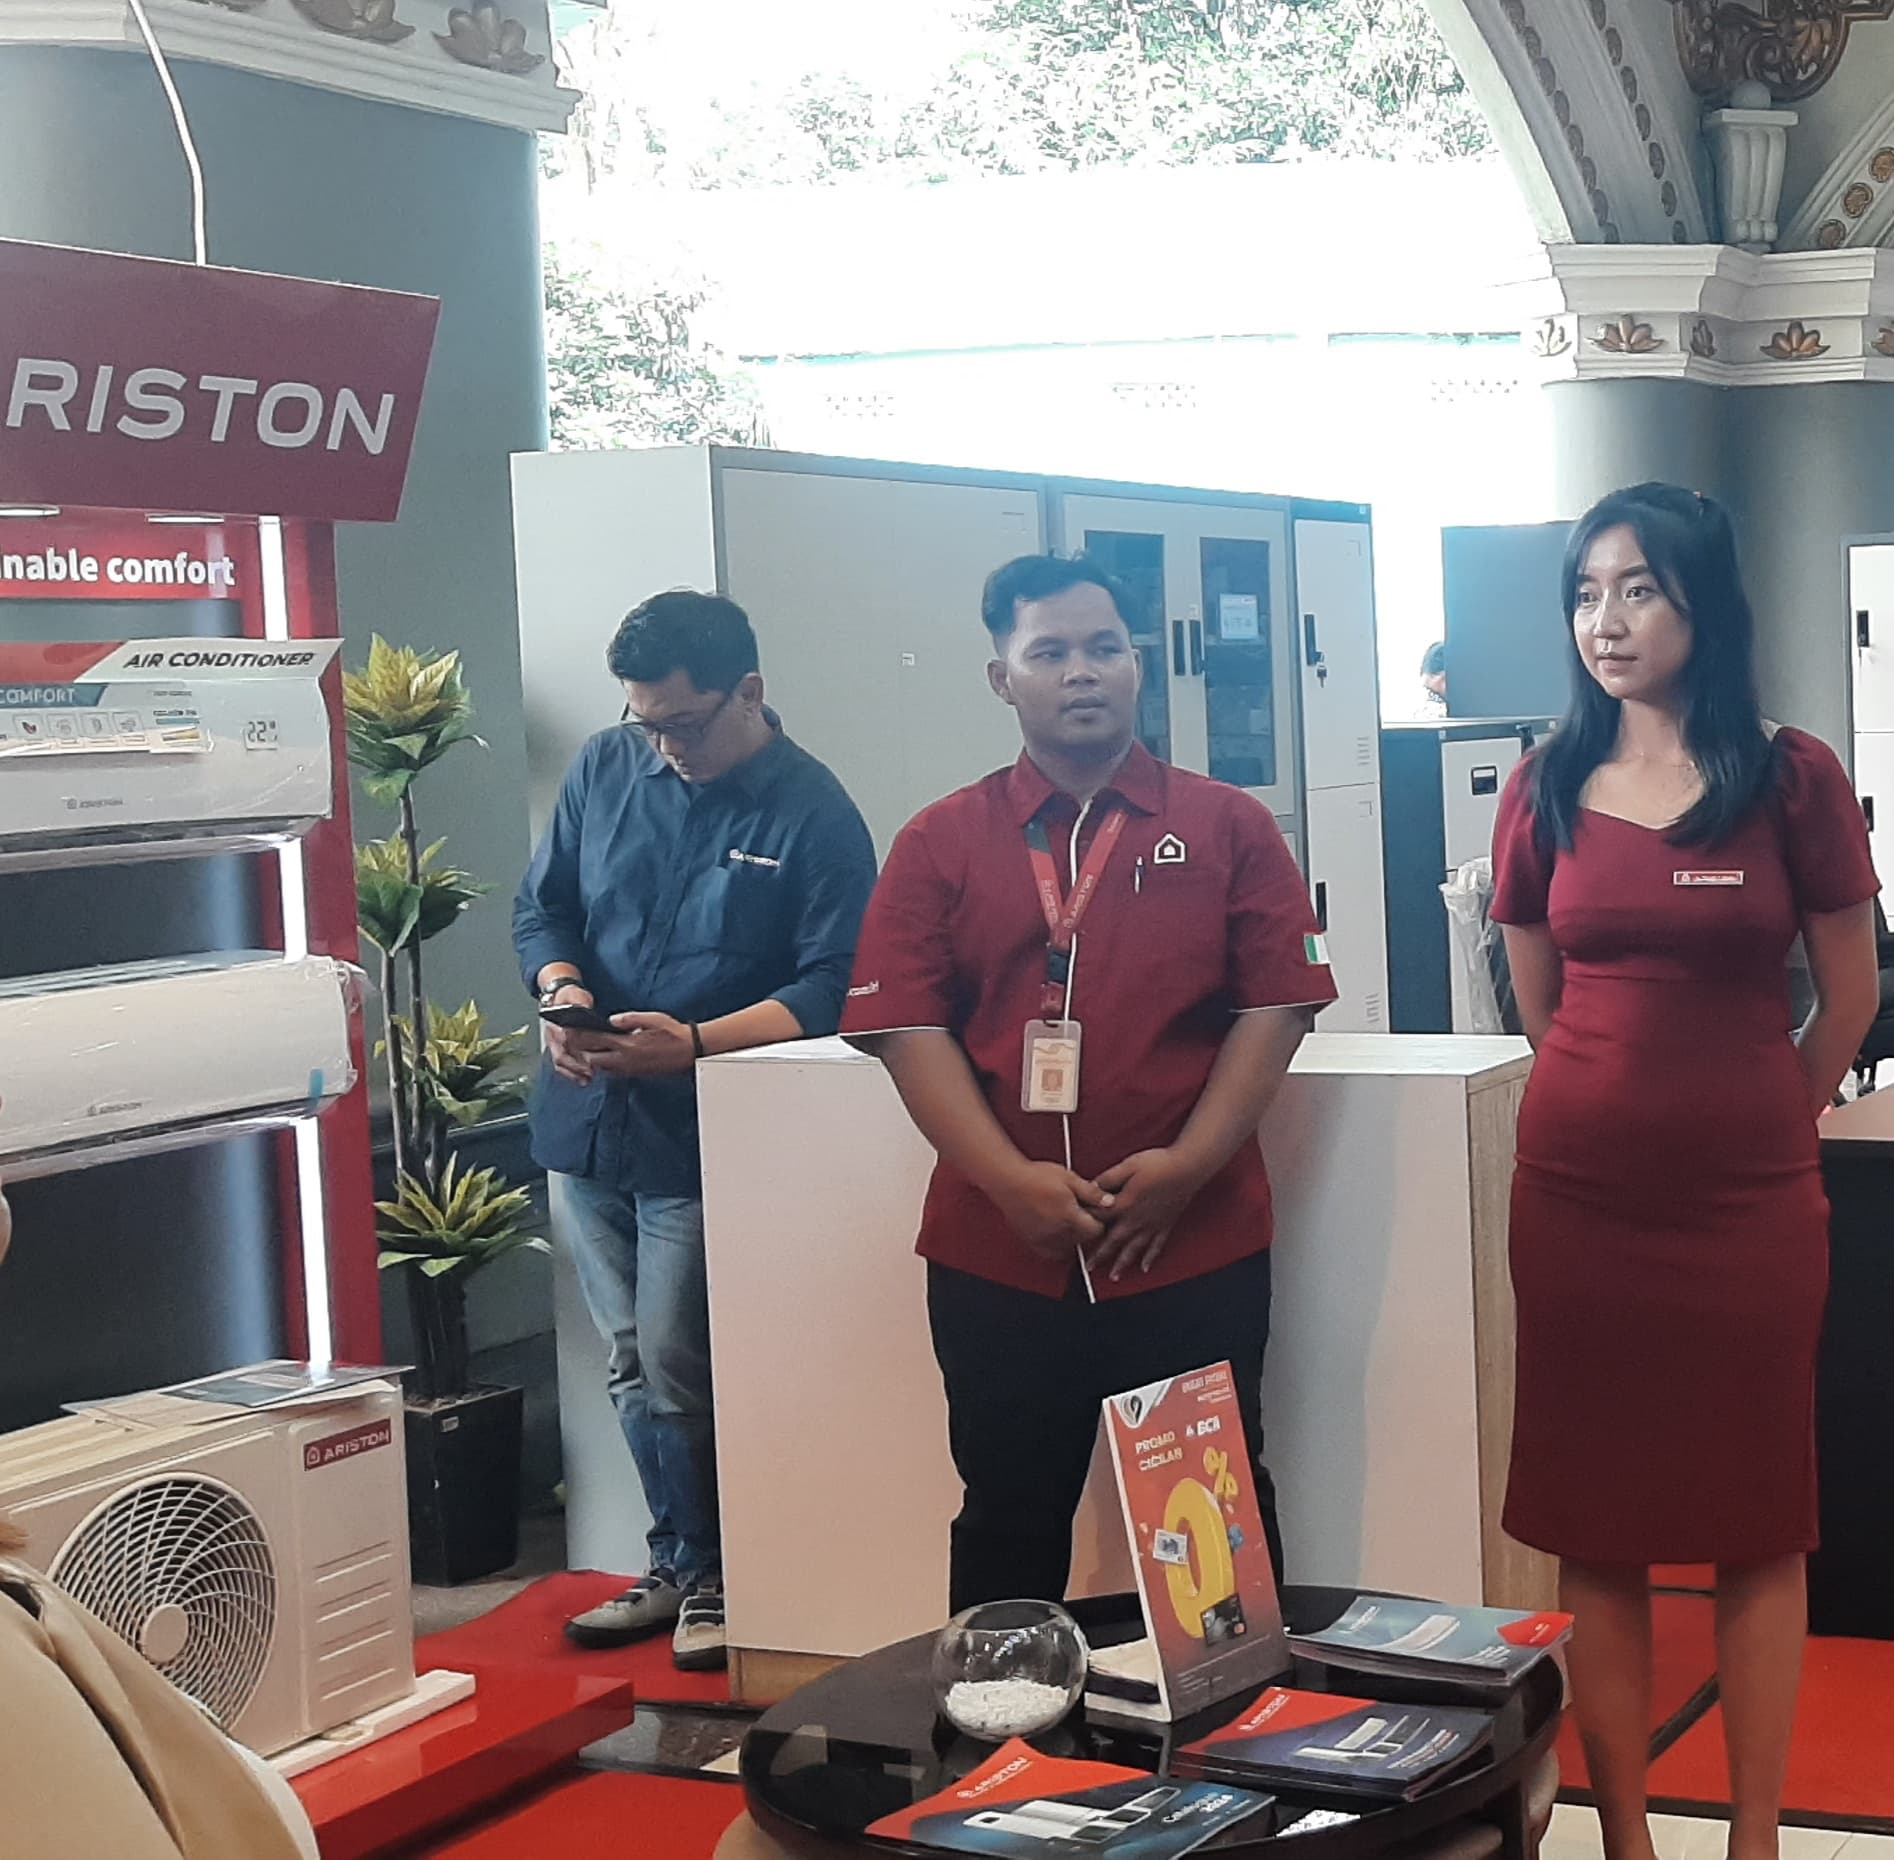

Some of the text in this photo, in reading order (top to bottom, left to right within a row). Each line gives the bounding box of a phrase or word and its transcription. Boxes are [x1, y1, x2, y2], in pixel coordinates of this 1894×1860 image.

[6, 357, 395, 456] RISTON
[0, 547, 235, 586] nable comfort
[123, 651, 315, 669] AIR CONDITIONER
[324, 1429, 390, 1462] ARISTON
